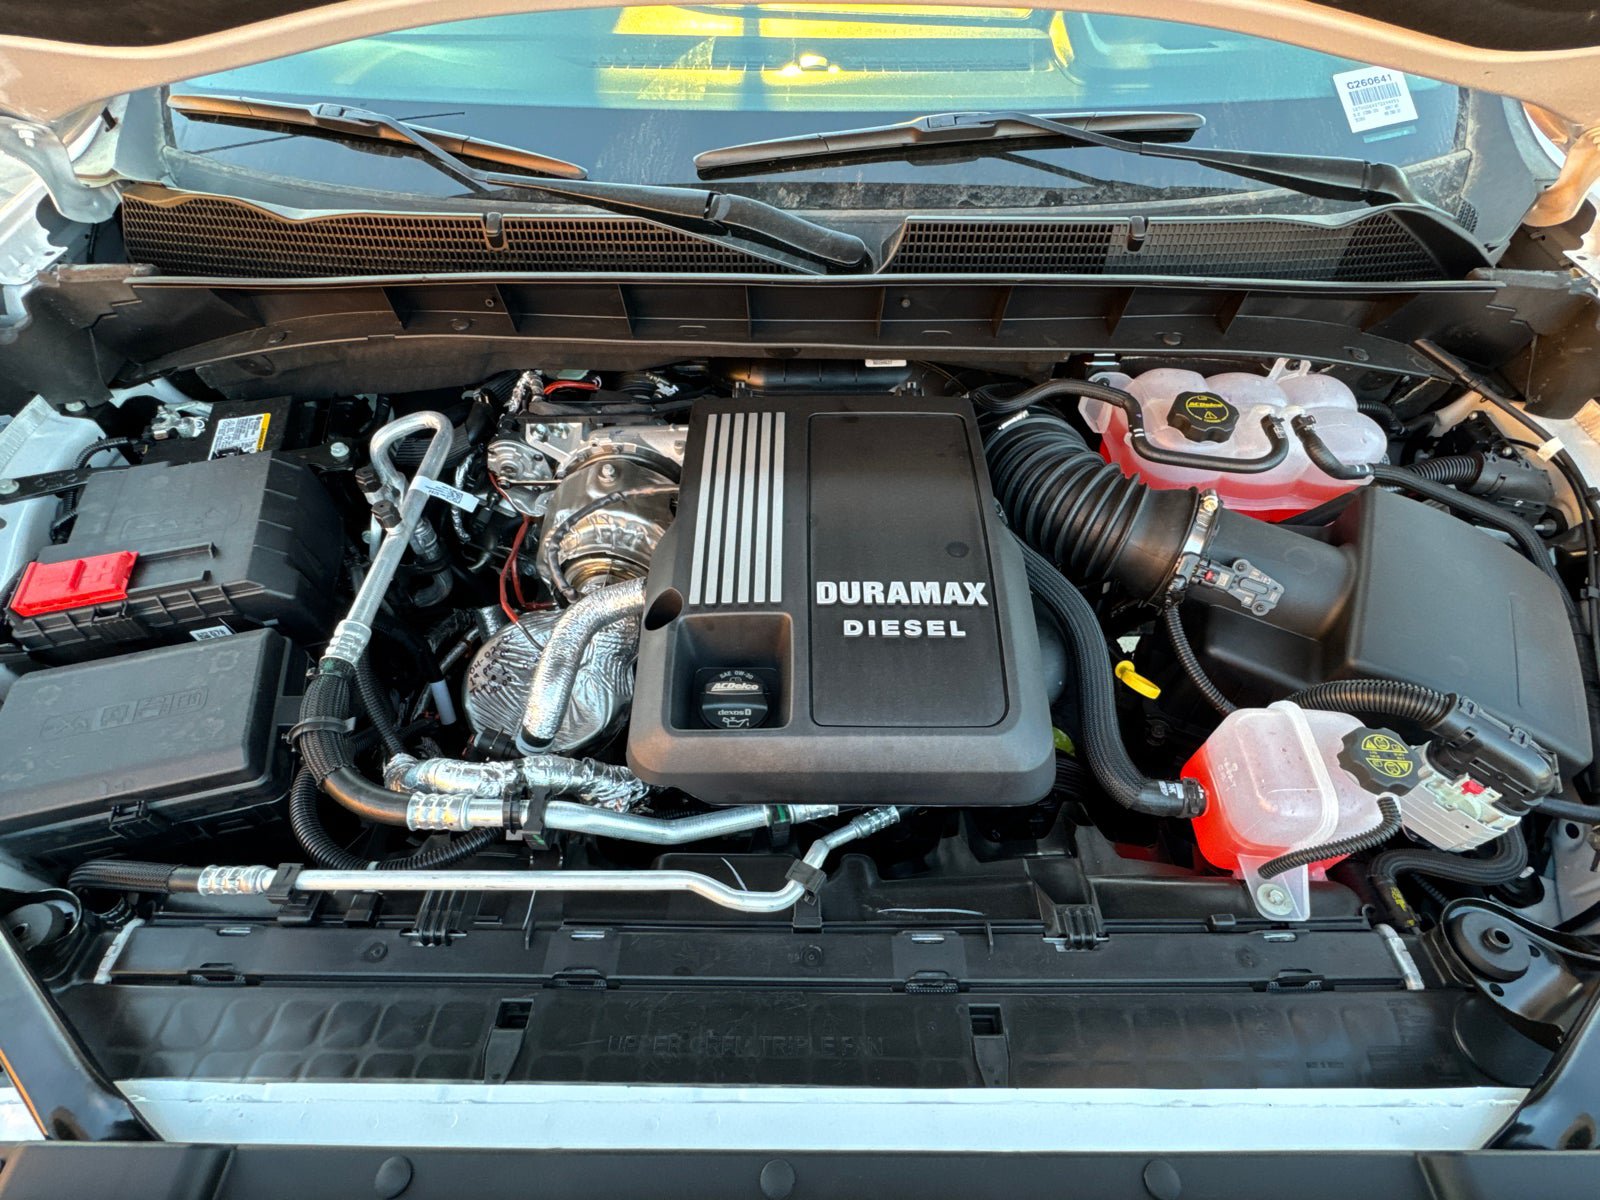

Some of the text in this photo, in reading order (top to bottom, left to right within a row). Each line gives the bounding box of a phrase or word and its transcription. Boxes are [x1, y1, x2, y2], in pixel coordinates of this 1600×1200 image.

[816, 580, 989, 606] DURAMAX
[843, 619, 967, 638] DIESEL
[710, 682, 760, 692] ACDelco
